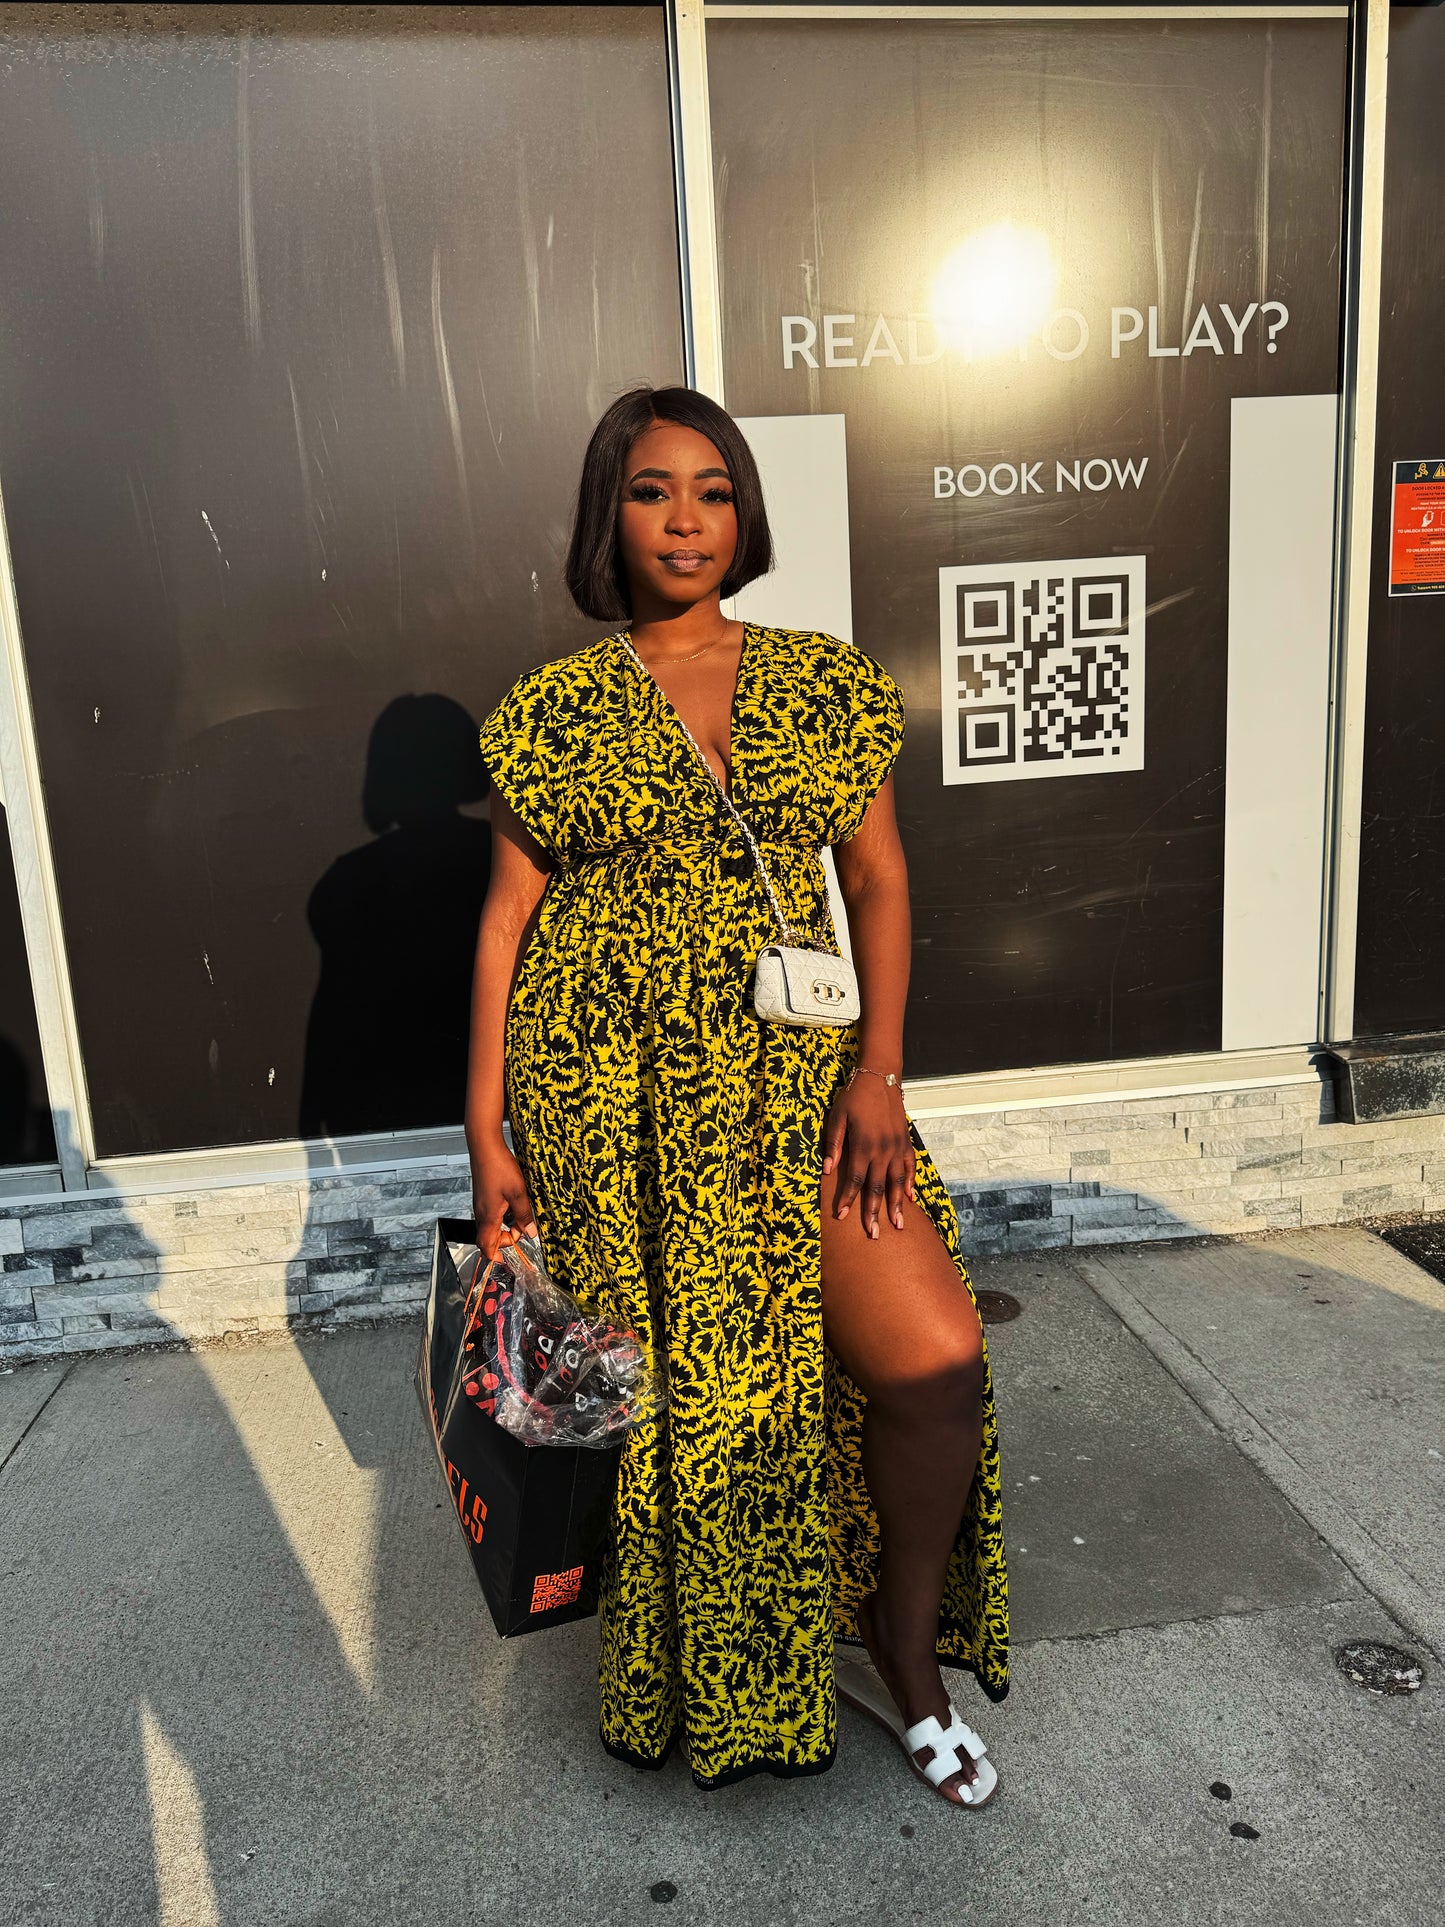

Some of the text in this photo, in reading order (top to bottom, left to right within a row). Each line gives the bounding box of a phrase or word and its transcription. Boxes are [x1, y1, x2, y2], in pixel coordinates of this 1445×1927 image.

[1111, 301, 1289, 359] PLAY?
[934, 457, 1149, 499] BOOK NOW
[446, 1459, 487, 1544] ELS
